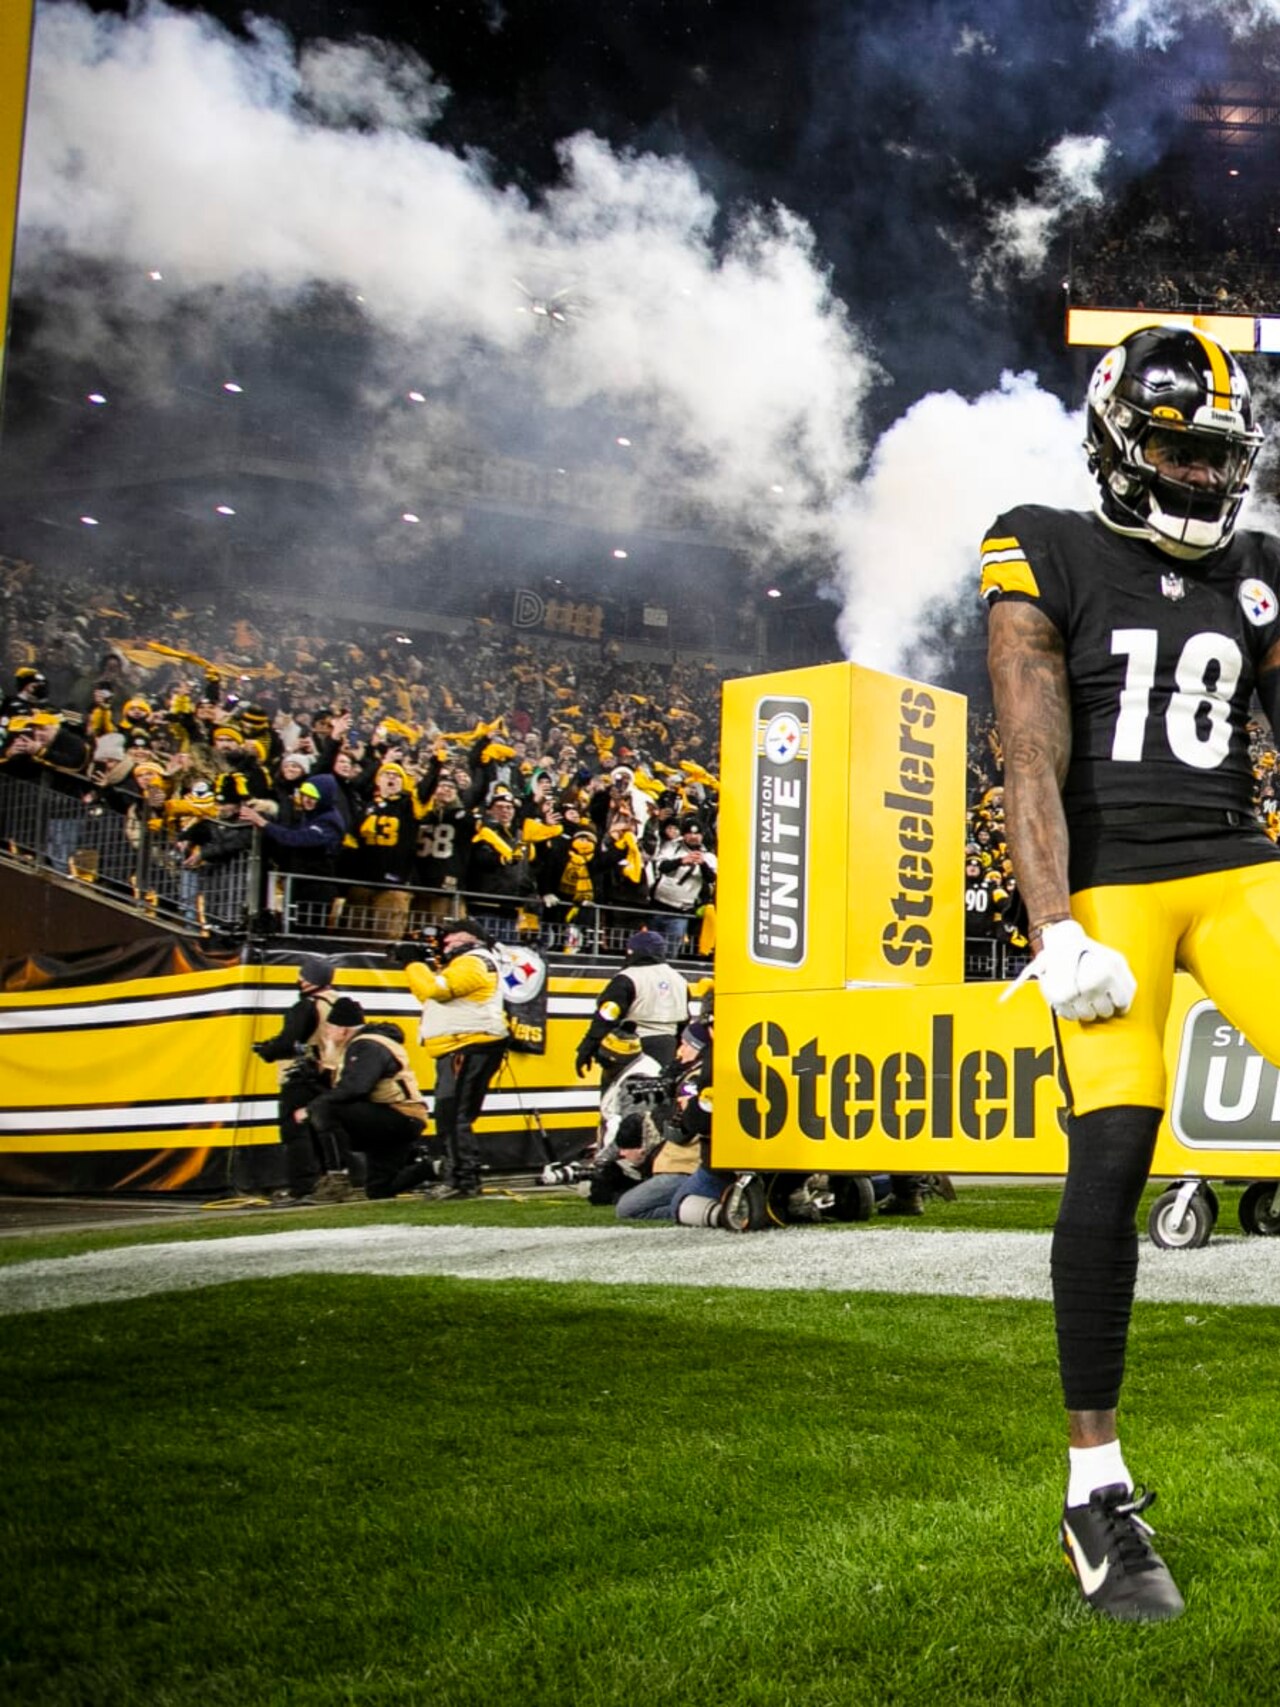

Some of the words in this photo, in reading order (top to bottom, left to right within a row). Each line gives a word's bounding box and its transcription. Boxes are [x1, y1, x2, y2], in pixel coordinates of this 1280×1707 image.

[1111, 628, 1243, 769] 18
[359, 814, 400, 847] 43
[417, 823, 456, 859] 58
[761, 775, 773, 844] NATION
[881, 687, 936, 968] Steelers
[759, 850, 772, 945] STEELERS
[770, 776, 801, 951] UNITE
[965, 888, 988, 912] 90
